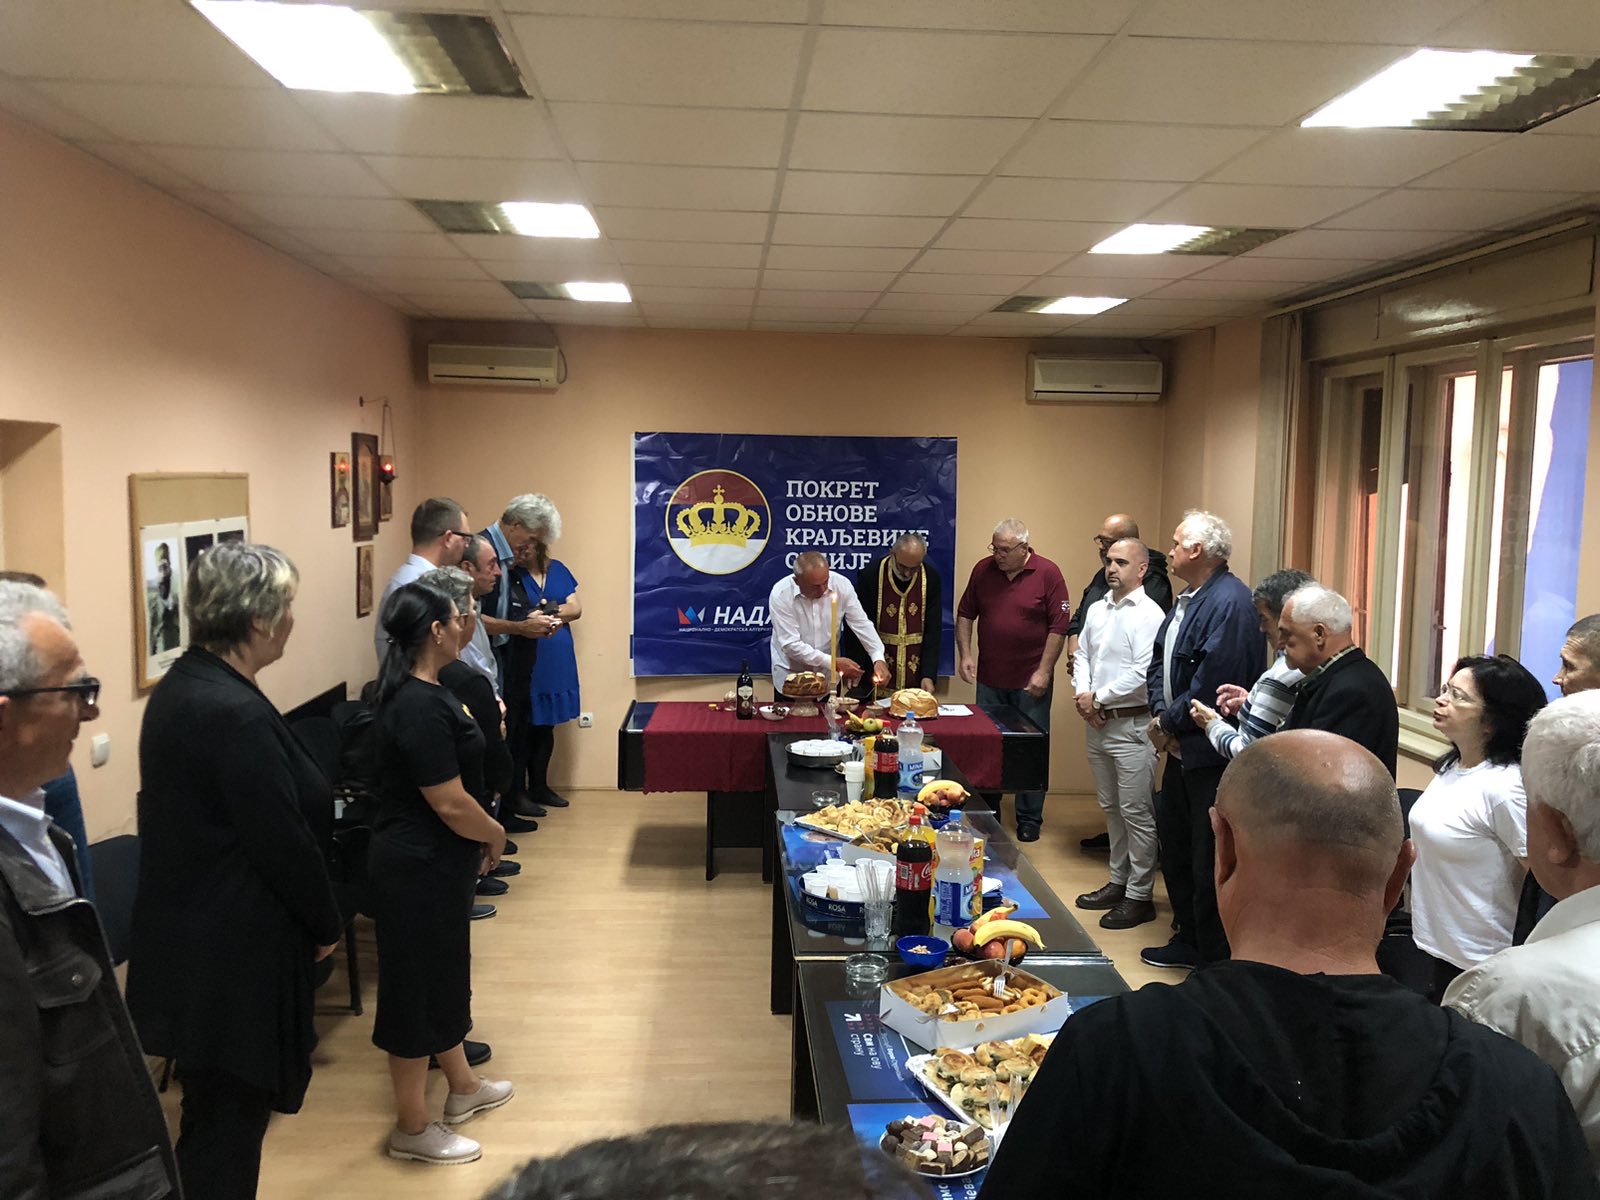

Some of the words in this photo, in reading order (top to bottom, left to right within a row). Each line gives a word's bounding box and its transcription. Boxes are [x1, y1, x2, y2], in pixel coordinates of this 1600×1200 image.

[785, 479, 879, 499] ПОКРЕТ
[785, 503, 878, 523] ОБНОВЕ
[785, 527, 930, 547] КРАЉЕВИЕ
[785, 551, 872, 570] СИЈЕ
[828, 903, 846, 913] ROSA
